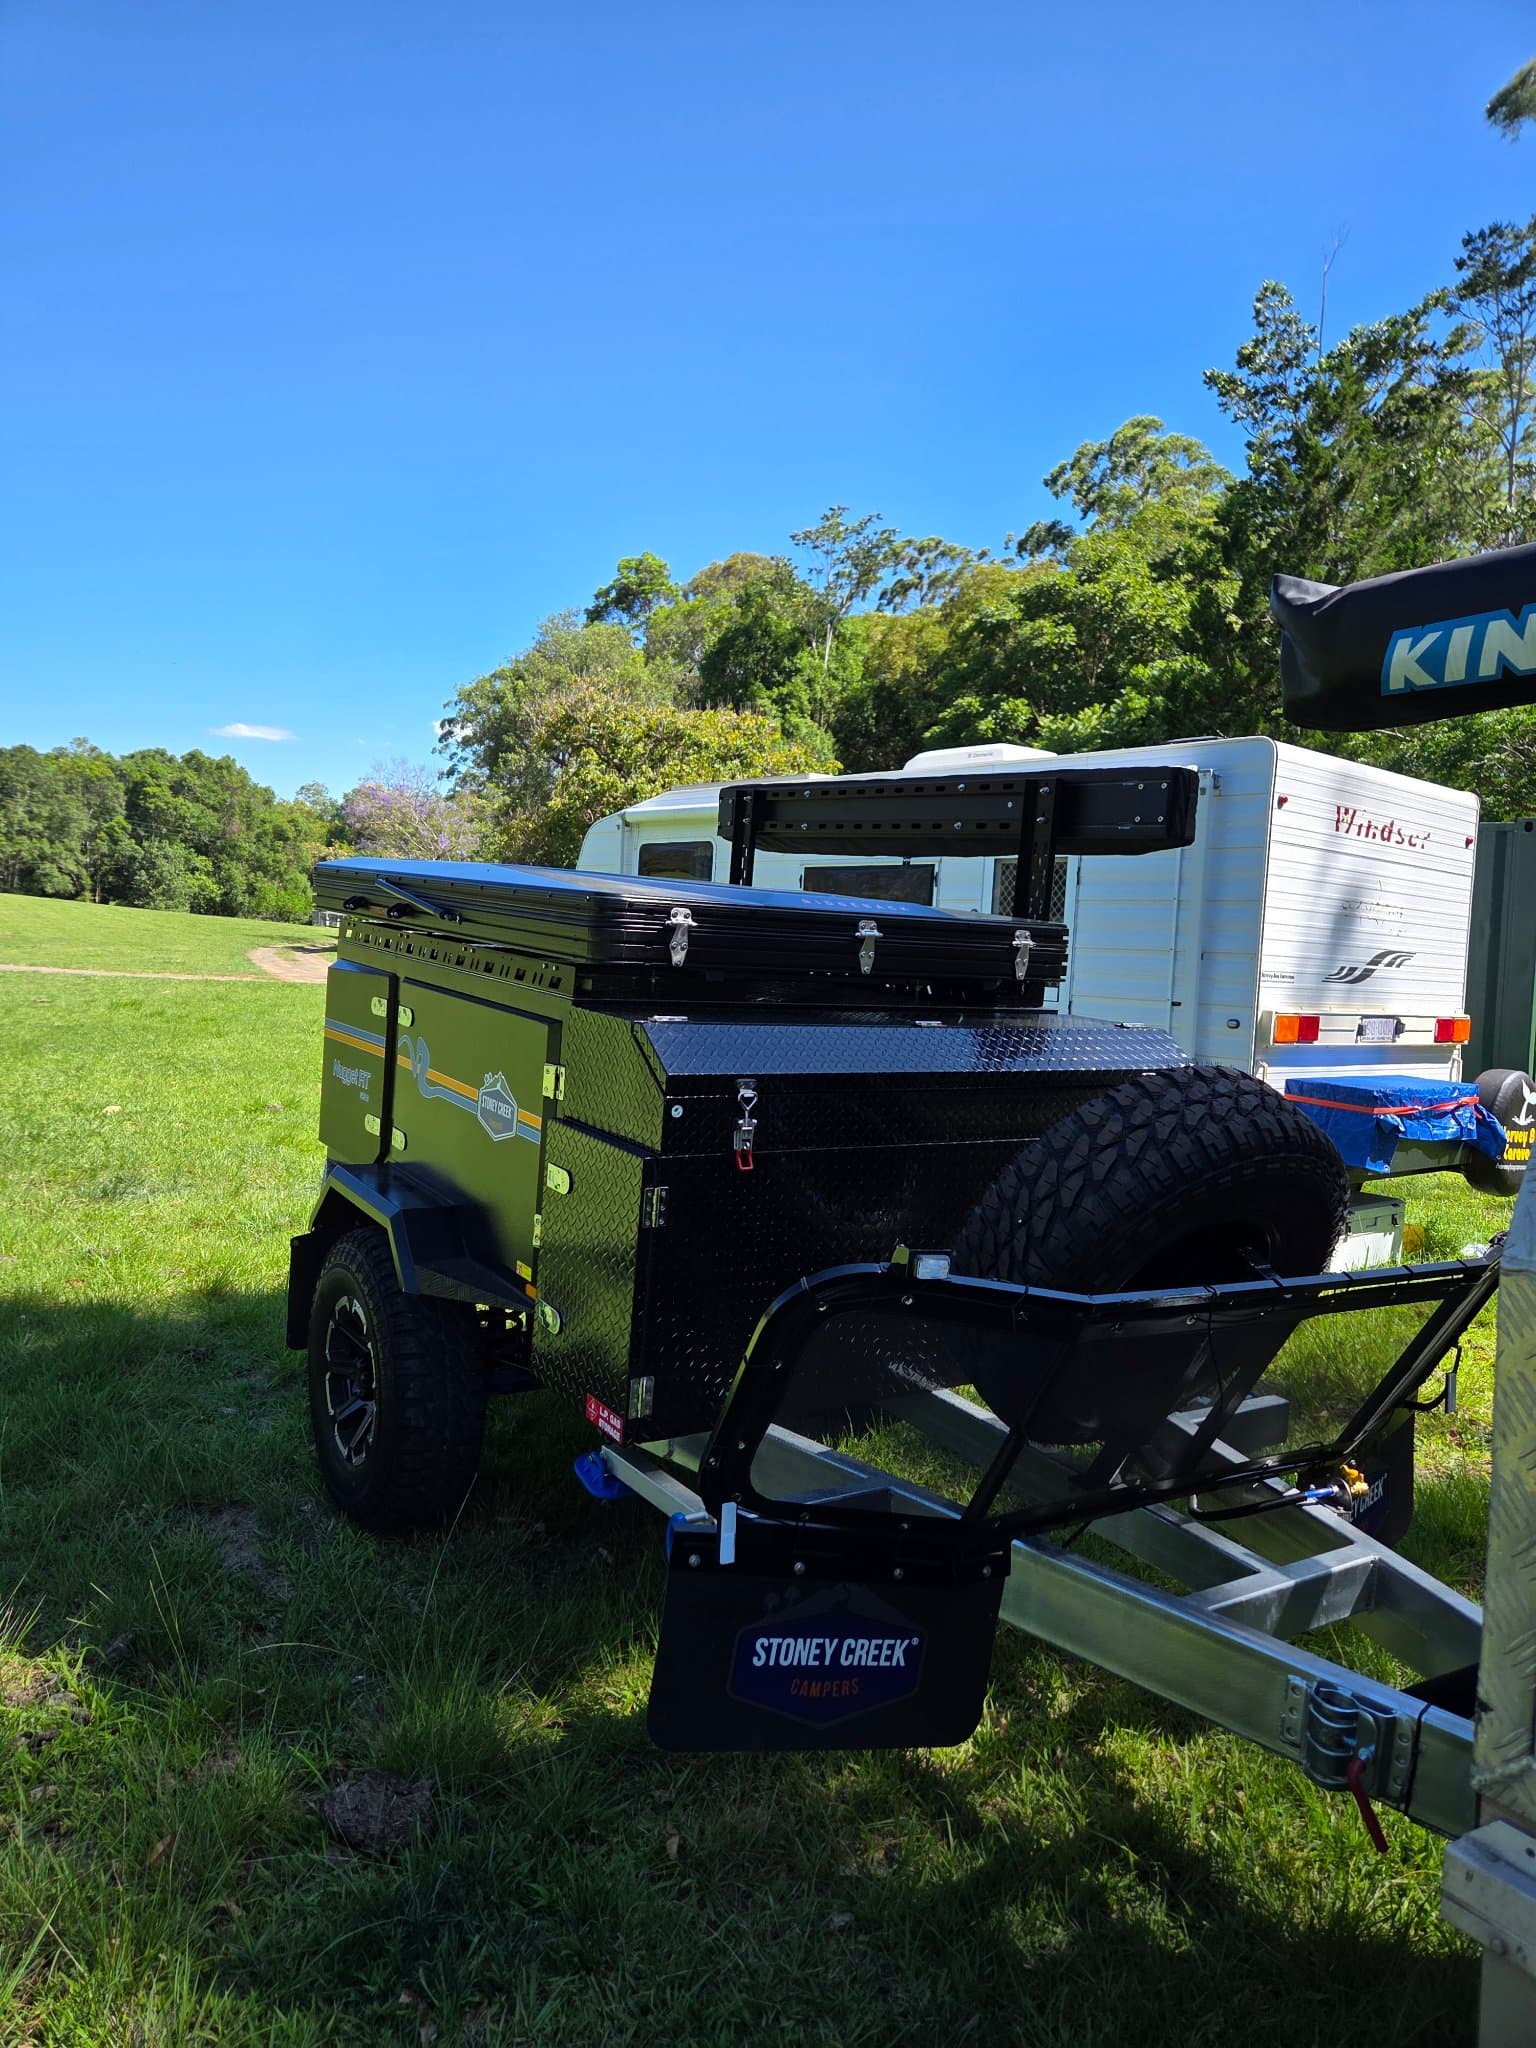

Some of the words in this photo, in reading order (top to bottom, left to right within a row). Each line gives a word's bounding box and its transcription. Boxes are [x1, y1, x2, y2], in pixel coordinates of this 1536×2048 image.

[1389, 612, 1536, 690] KIN
[752, 1637, 839, 1667] STONEY
[790, 1677, 861, 1698] CAMPERS
